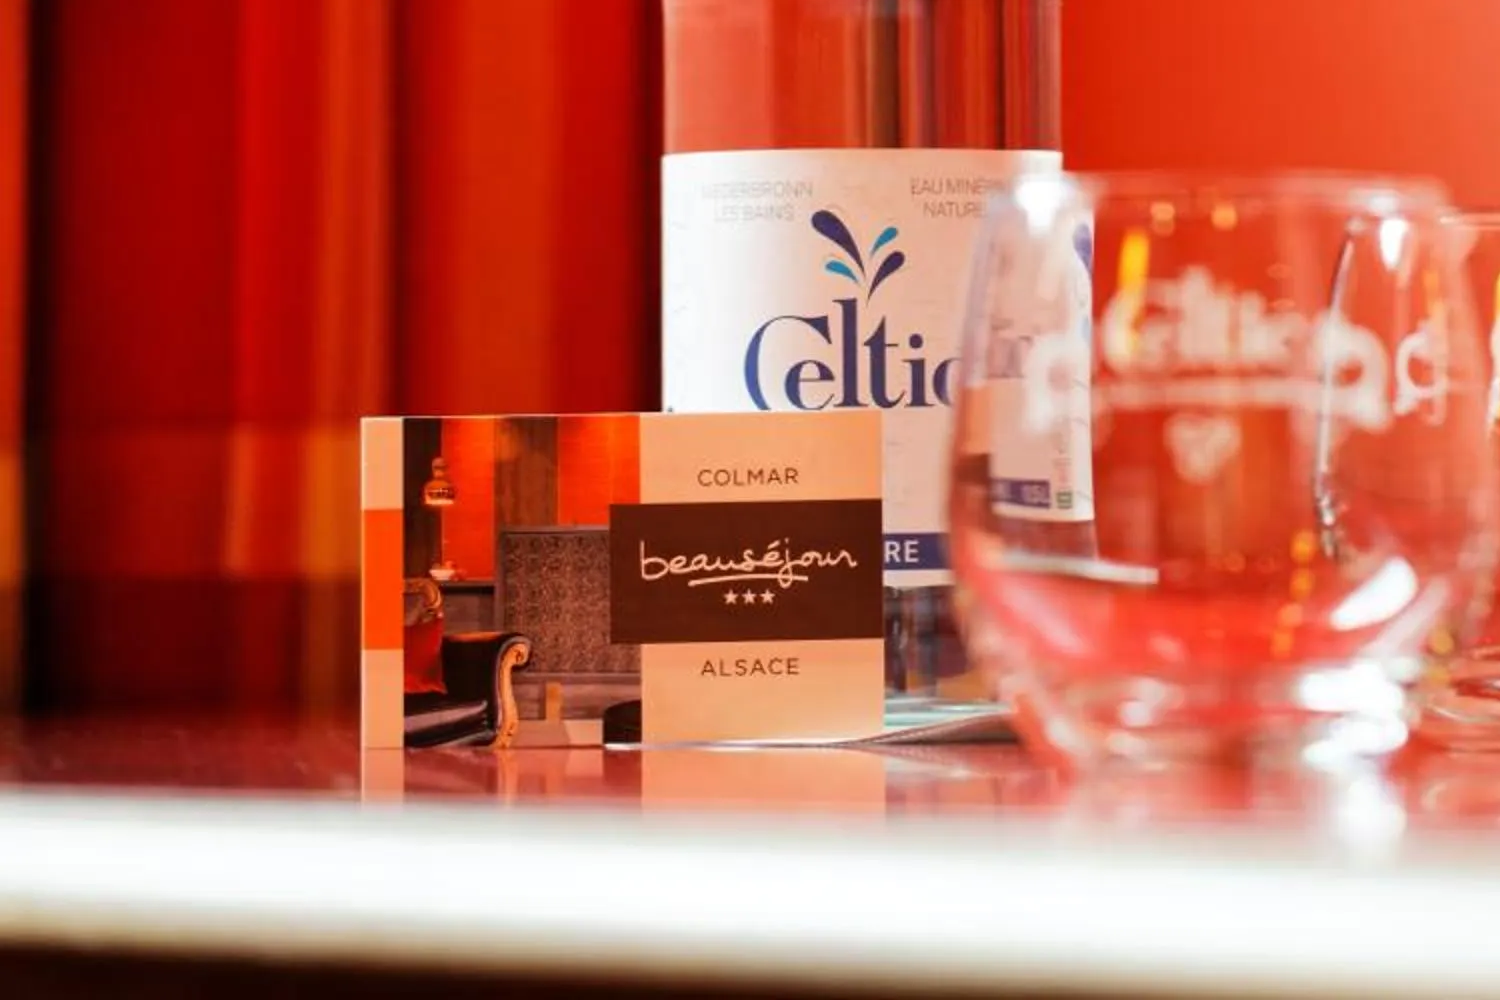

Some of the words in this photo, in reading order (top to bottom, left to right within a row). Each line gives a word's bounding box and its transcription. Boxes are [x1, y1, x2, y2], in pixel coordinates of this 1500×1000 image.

[697, 467, 800, 487] COLMAR
[640, 537, 858, 588] beauséjour
[701, 657, 801, 677] ALSACE
